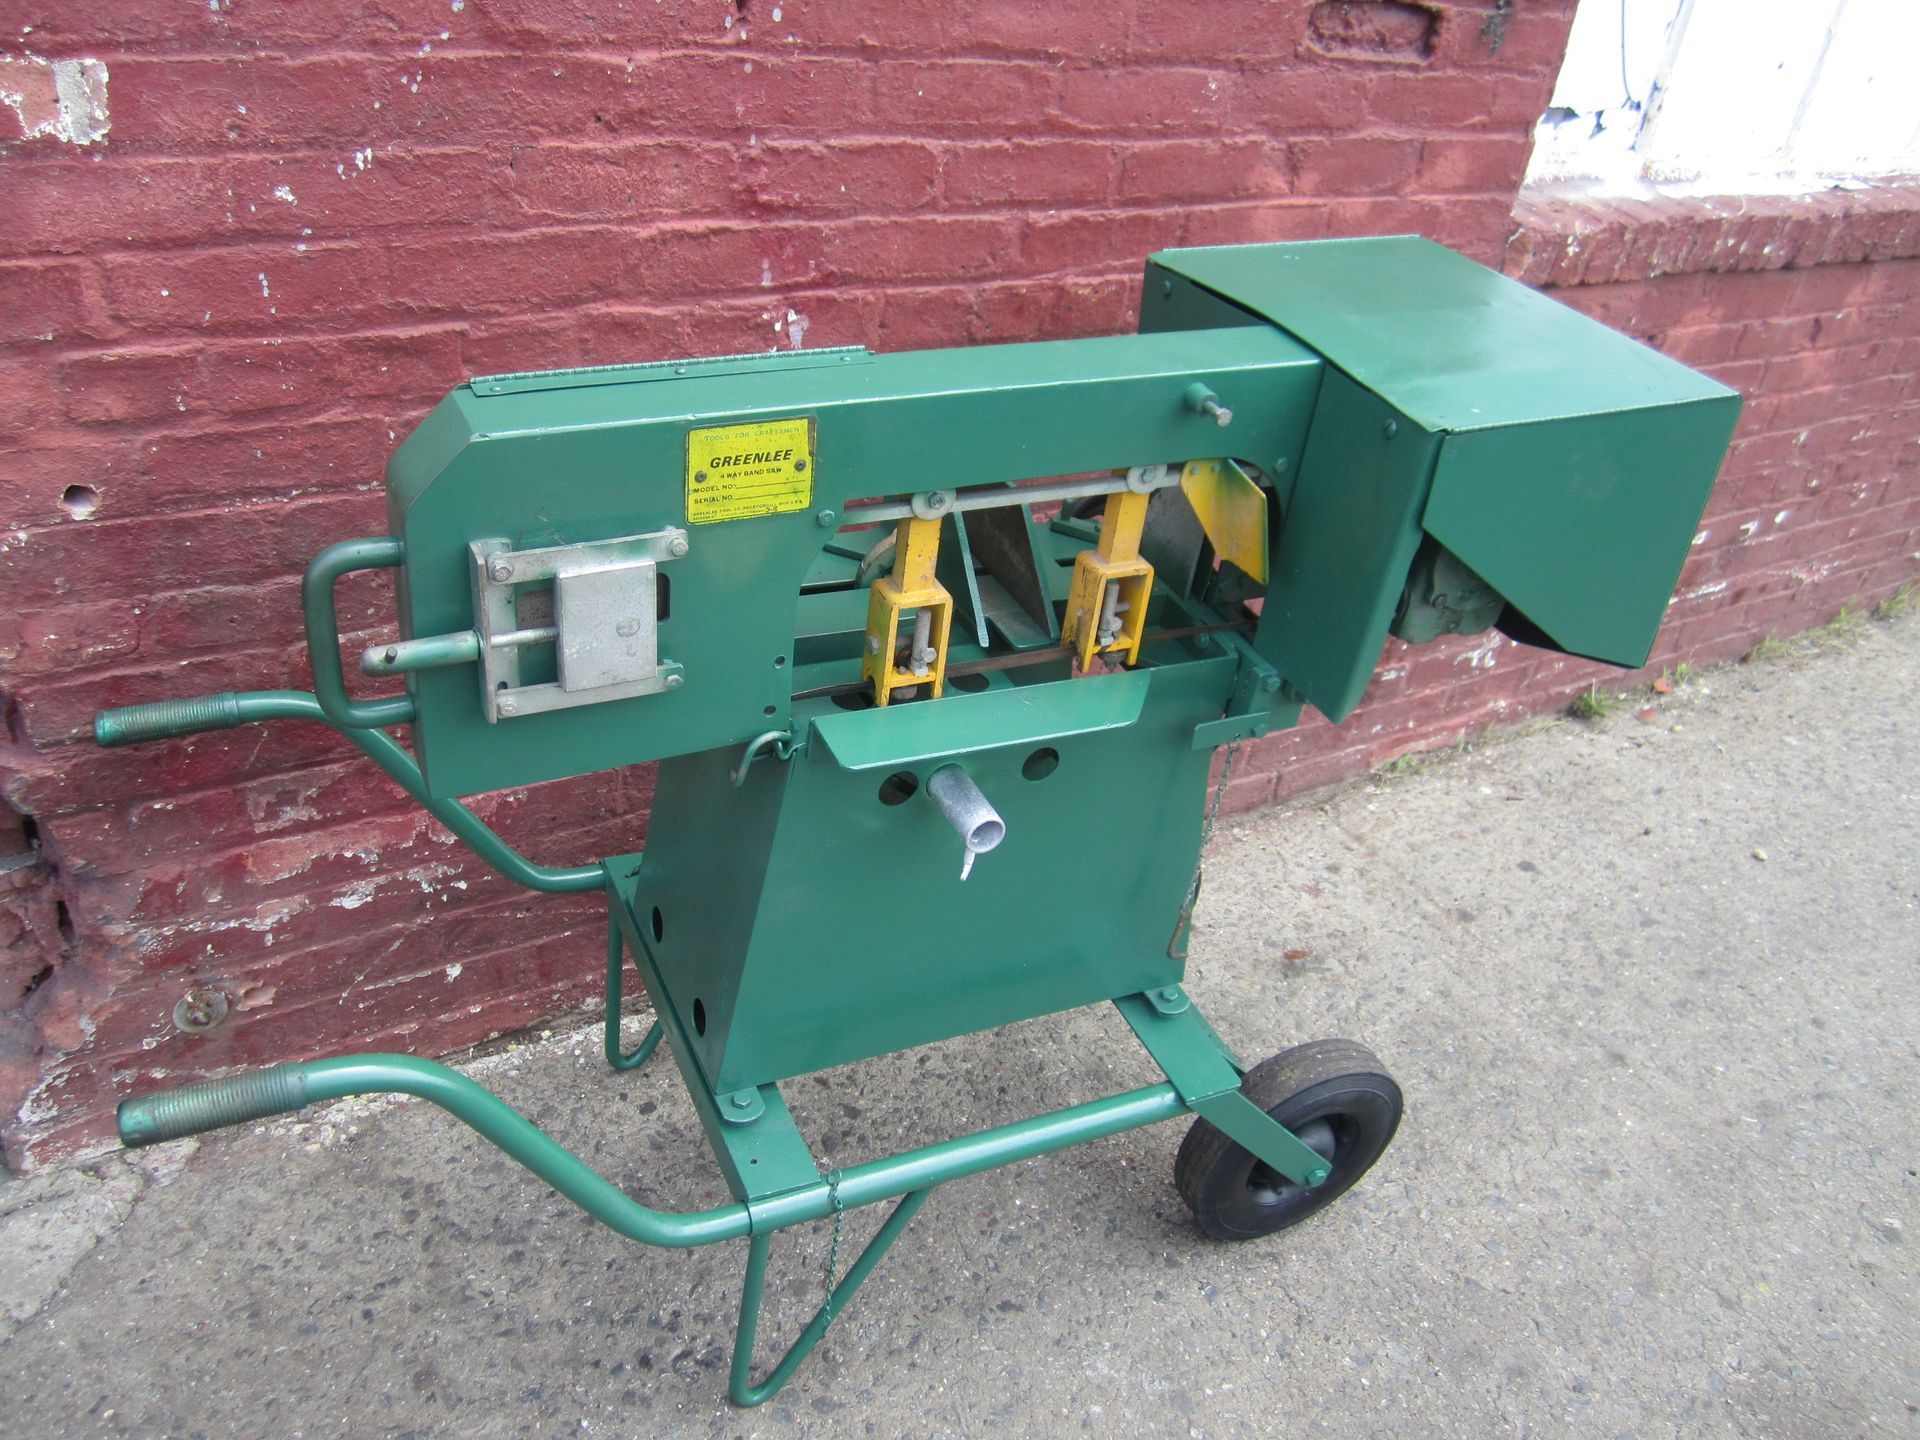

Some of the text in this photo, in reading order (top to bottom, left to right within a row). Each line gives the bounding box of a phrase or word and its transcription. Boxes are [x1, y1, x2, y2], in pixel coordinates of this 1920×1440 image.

[709, 448, 793, 469] GREENLEE
[726, 471, 742, 479] WAY
[743, 469, 765, 477] BAND
[693, 485, 720, 494] MODEL
[693, 497, 721, 505] SERIAL
